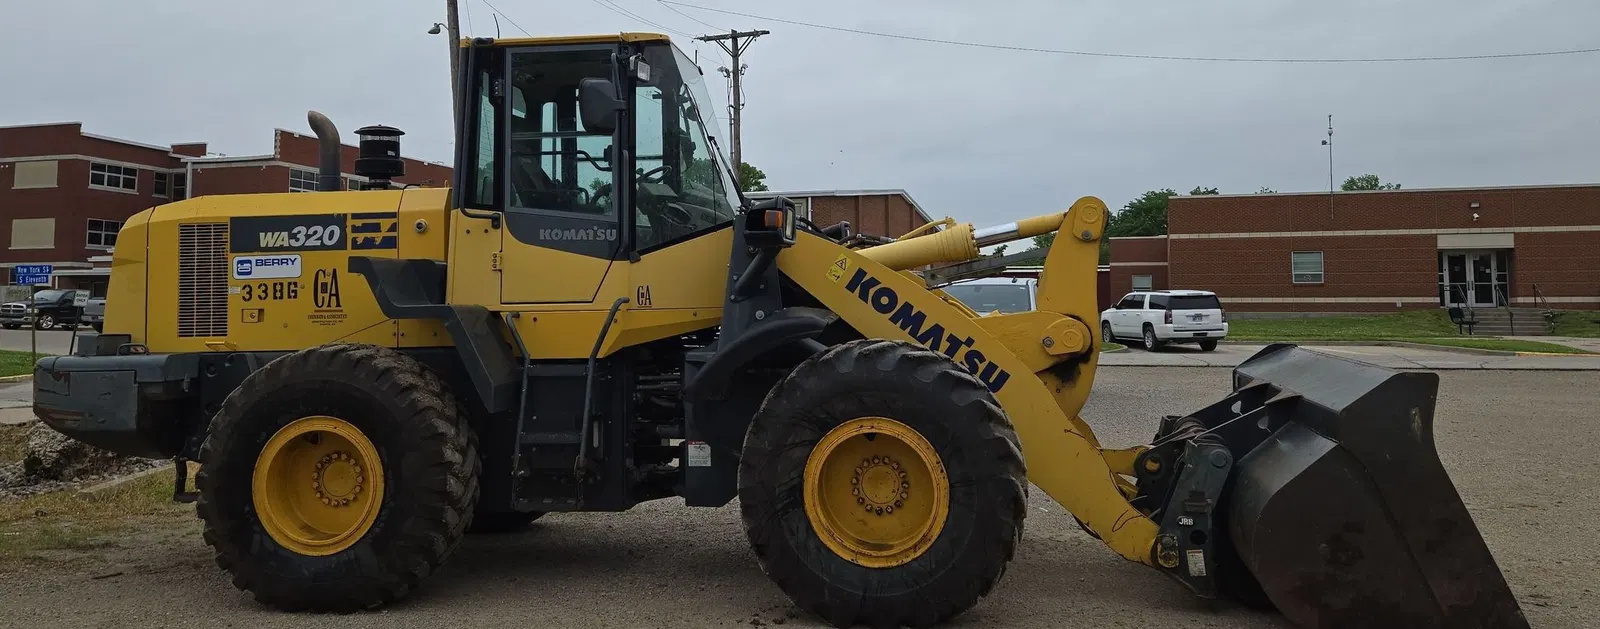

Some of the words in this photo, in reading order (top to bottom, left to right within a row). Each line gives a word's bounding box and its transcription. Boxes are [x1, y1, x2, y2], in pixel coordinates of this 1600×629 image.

[259, 225, 340, 248] WA320
[540, 226, 616, 241] KOMATSU
[255, 258, 297, 267] BERRY
[25, 275, 47, 283] Eleventh
[845, 267, 1011, 393] KOMATSU
[1178, 517, 1194, 526] JRB
